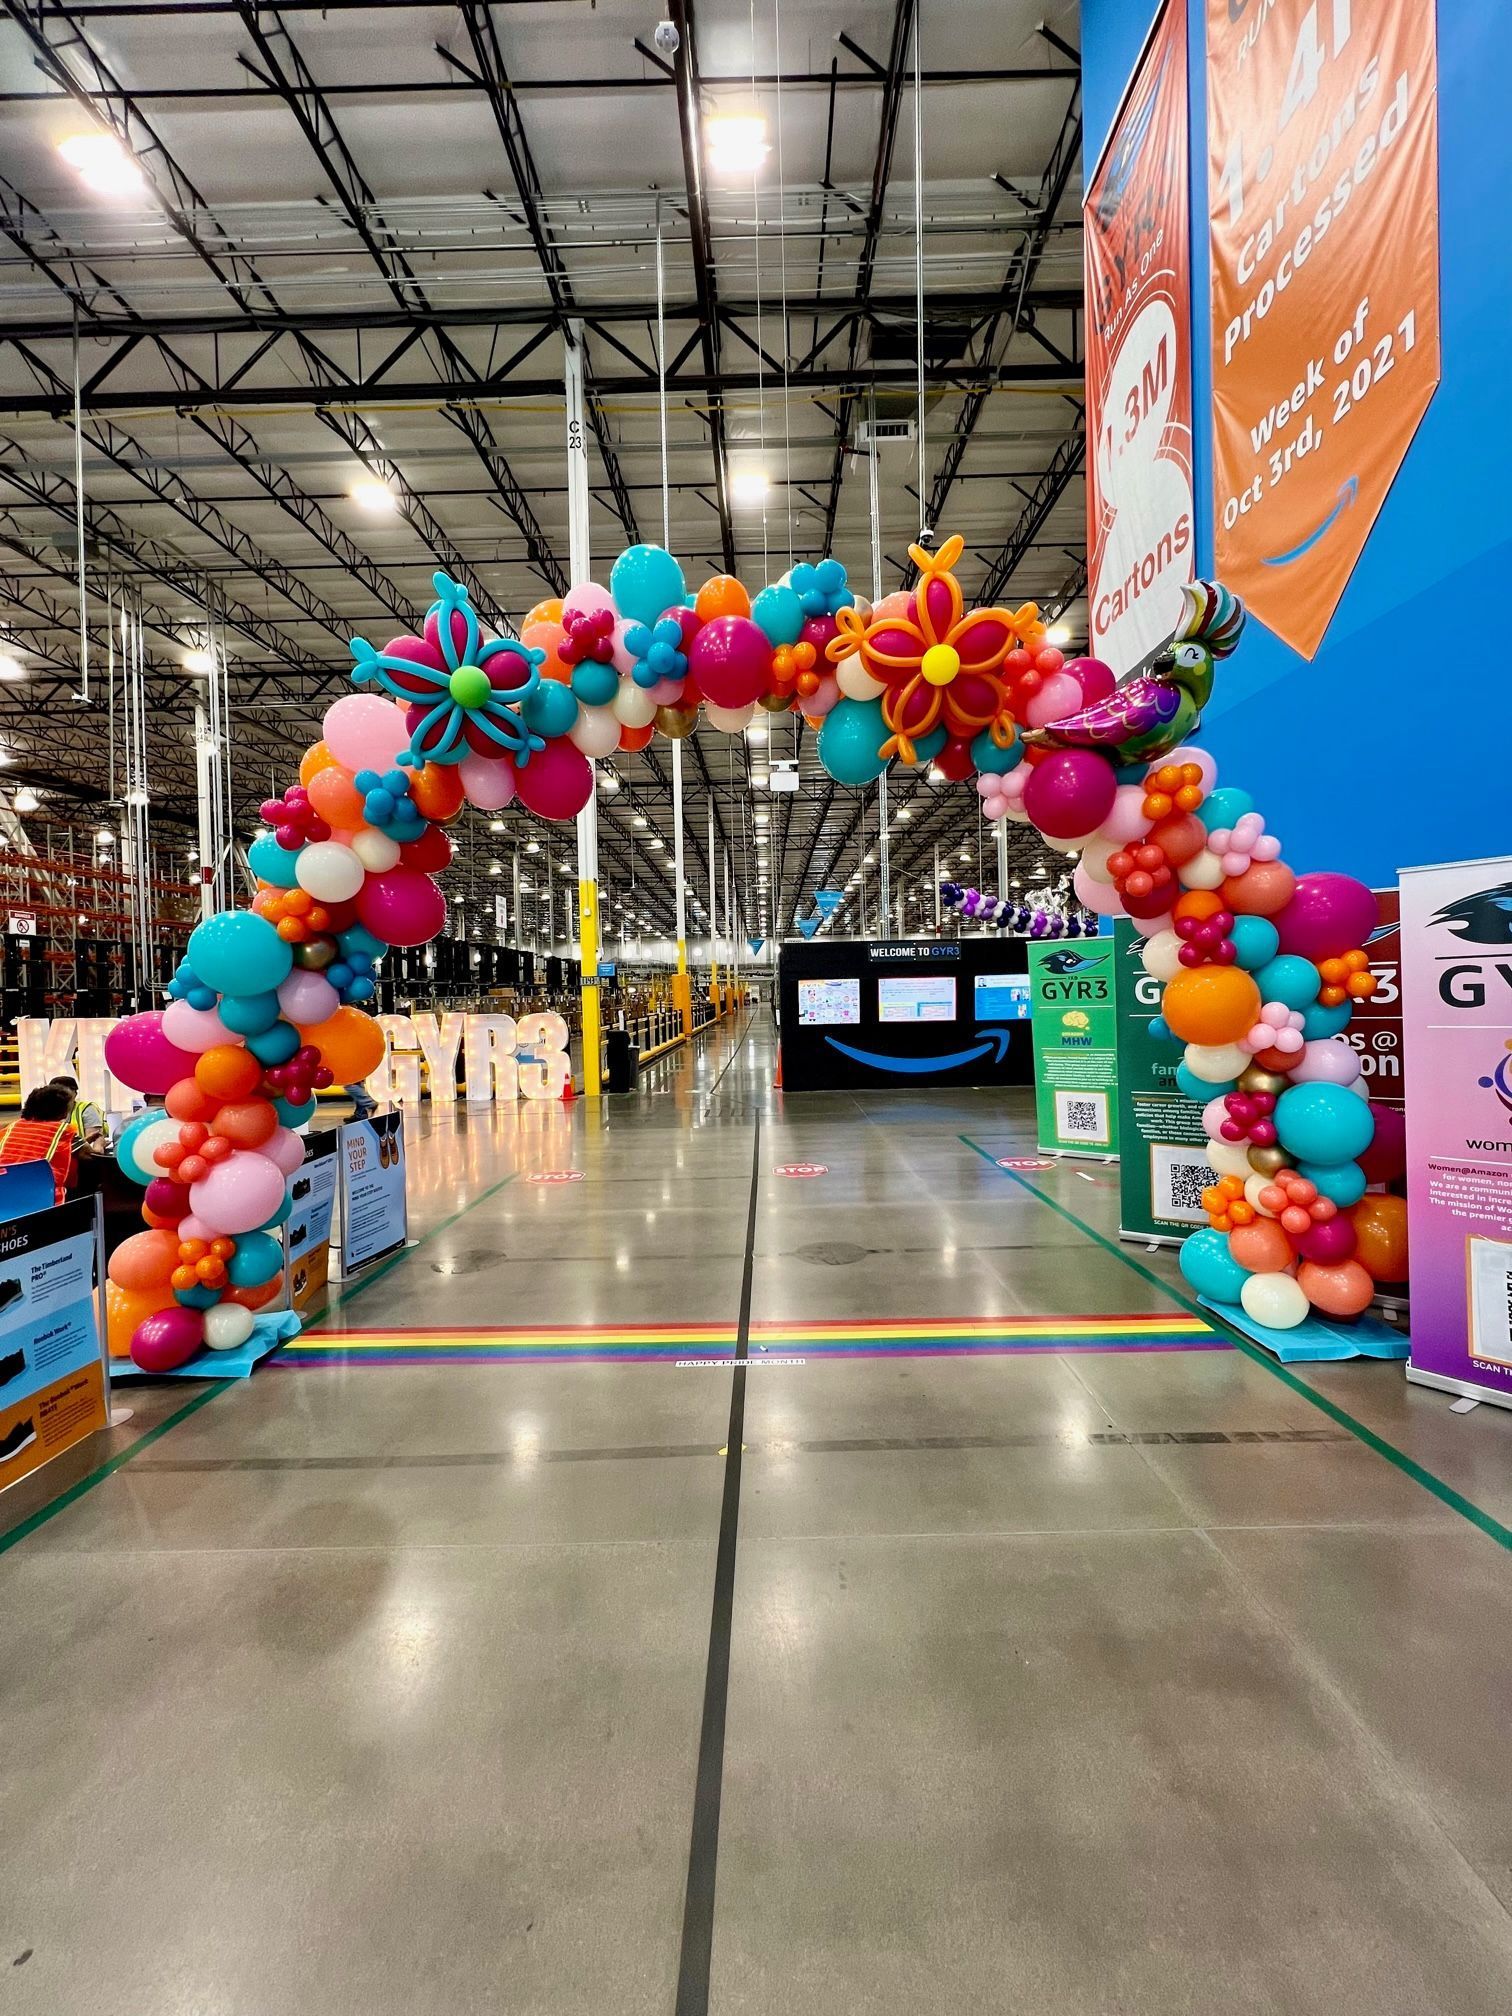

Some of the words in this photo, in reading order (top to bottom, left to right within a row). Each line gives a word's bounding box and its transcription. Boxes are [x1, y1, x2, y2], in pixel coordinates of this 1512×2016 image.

[1237, 55, 1379, 284] Cartons
[1225, 71, 1408, 366] Processed
[1250, 357, 1326, 455] Week
[1333, 297, 1369, 365] of
[1223, 474, 1263, 530] Oct
[1269, 414, 1323, 487] 3rd,
[1333, 309, 1416, 425] 2021
[569, 420, 580, 434] C
[569, 436, 582, 449] 23
[1095, 513, 1190, 636] Cartons
[870, 947, 916, 957] WELCOME
[918, 947, 930, 957] TO
[931, 947, 960, 956] GYR3
[1042, 980, 1108, 1000] GYR3
[1062, 1037, 1092, 1046] MHW
[365, 1013, 572, 1101] GYR3
[347, 1137, 365, 1149] MIND
[349, 1147, 367, 1161] YOUR
[350, 1160, 366, 1173] STEP
[1428, 1164, 1509, 1178] Women@Amazon
[1458, 1176, 1495, 1186] women,
[1429, 1197, 1446, 1205] The
[1448, 1201, 1482, 1210] mission
[1477, 1194, 1486, 1202] in
[1452, 1209, 1467, 1217] the
[1469, 1212, 1506, 1222] premier
[31, 1266, 42, 1274] The
[1473, 1360, 1501, 1373] SCAN
